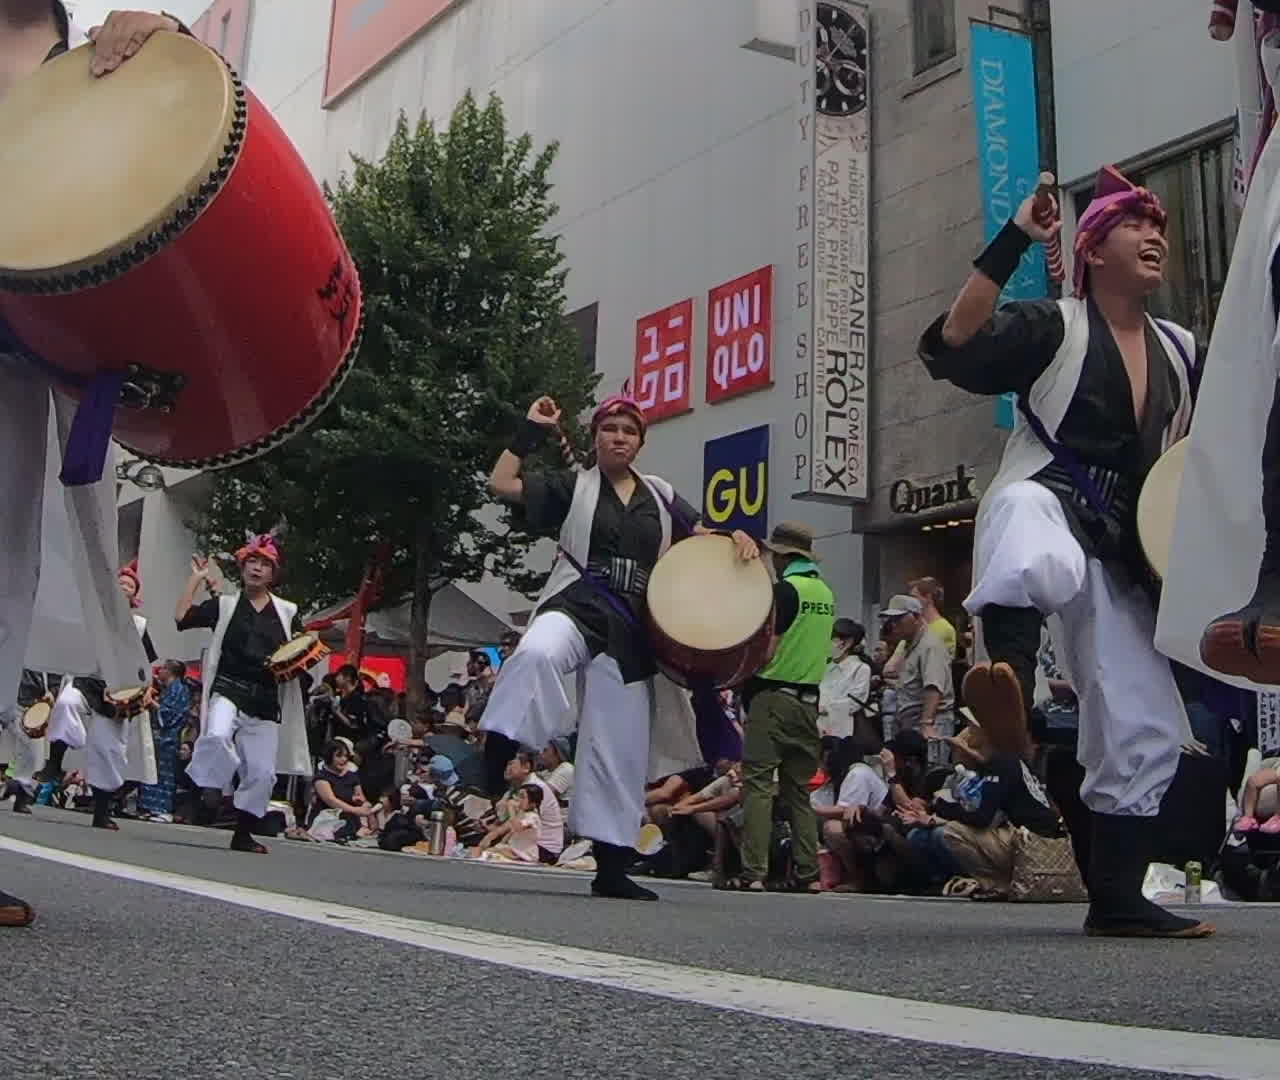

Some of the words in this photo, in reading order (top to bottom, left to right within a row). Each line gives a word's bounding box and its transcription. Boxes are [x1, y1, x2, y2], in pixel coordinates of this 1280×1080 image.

[796, 7, 812, 144] DUTY
[826, 159, 840, 232] PATEK
[795, 165, 810, 309] FREE
[714, 284, 761, 338] UNI
[826, 239, 840, 345] PHILIPPE
[642, 314, 685, 366] ユニ
[712, 331, 765, 391] QLO
[848, 270, 865, 403] PANERAI
[638, 360, 685, 411] クロ
[794, 332, 809, 481] SHOP
[824, 348, 848, 493] ROLEX
[847, 407, 860, 487] OMEGA
[705, 460, 767, 523] GU
[890, 462, 976, 516] Quark
